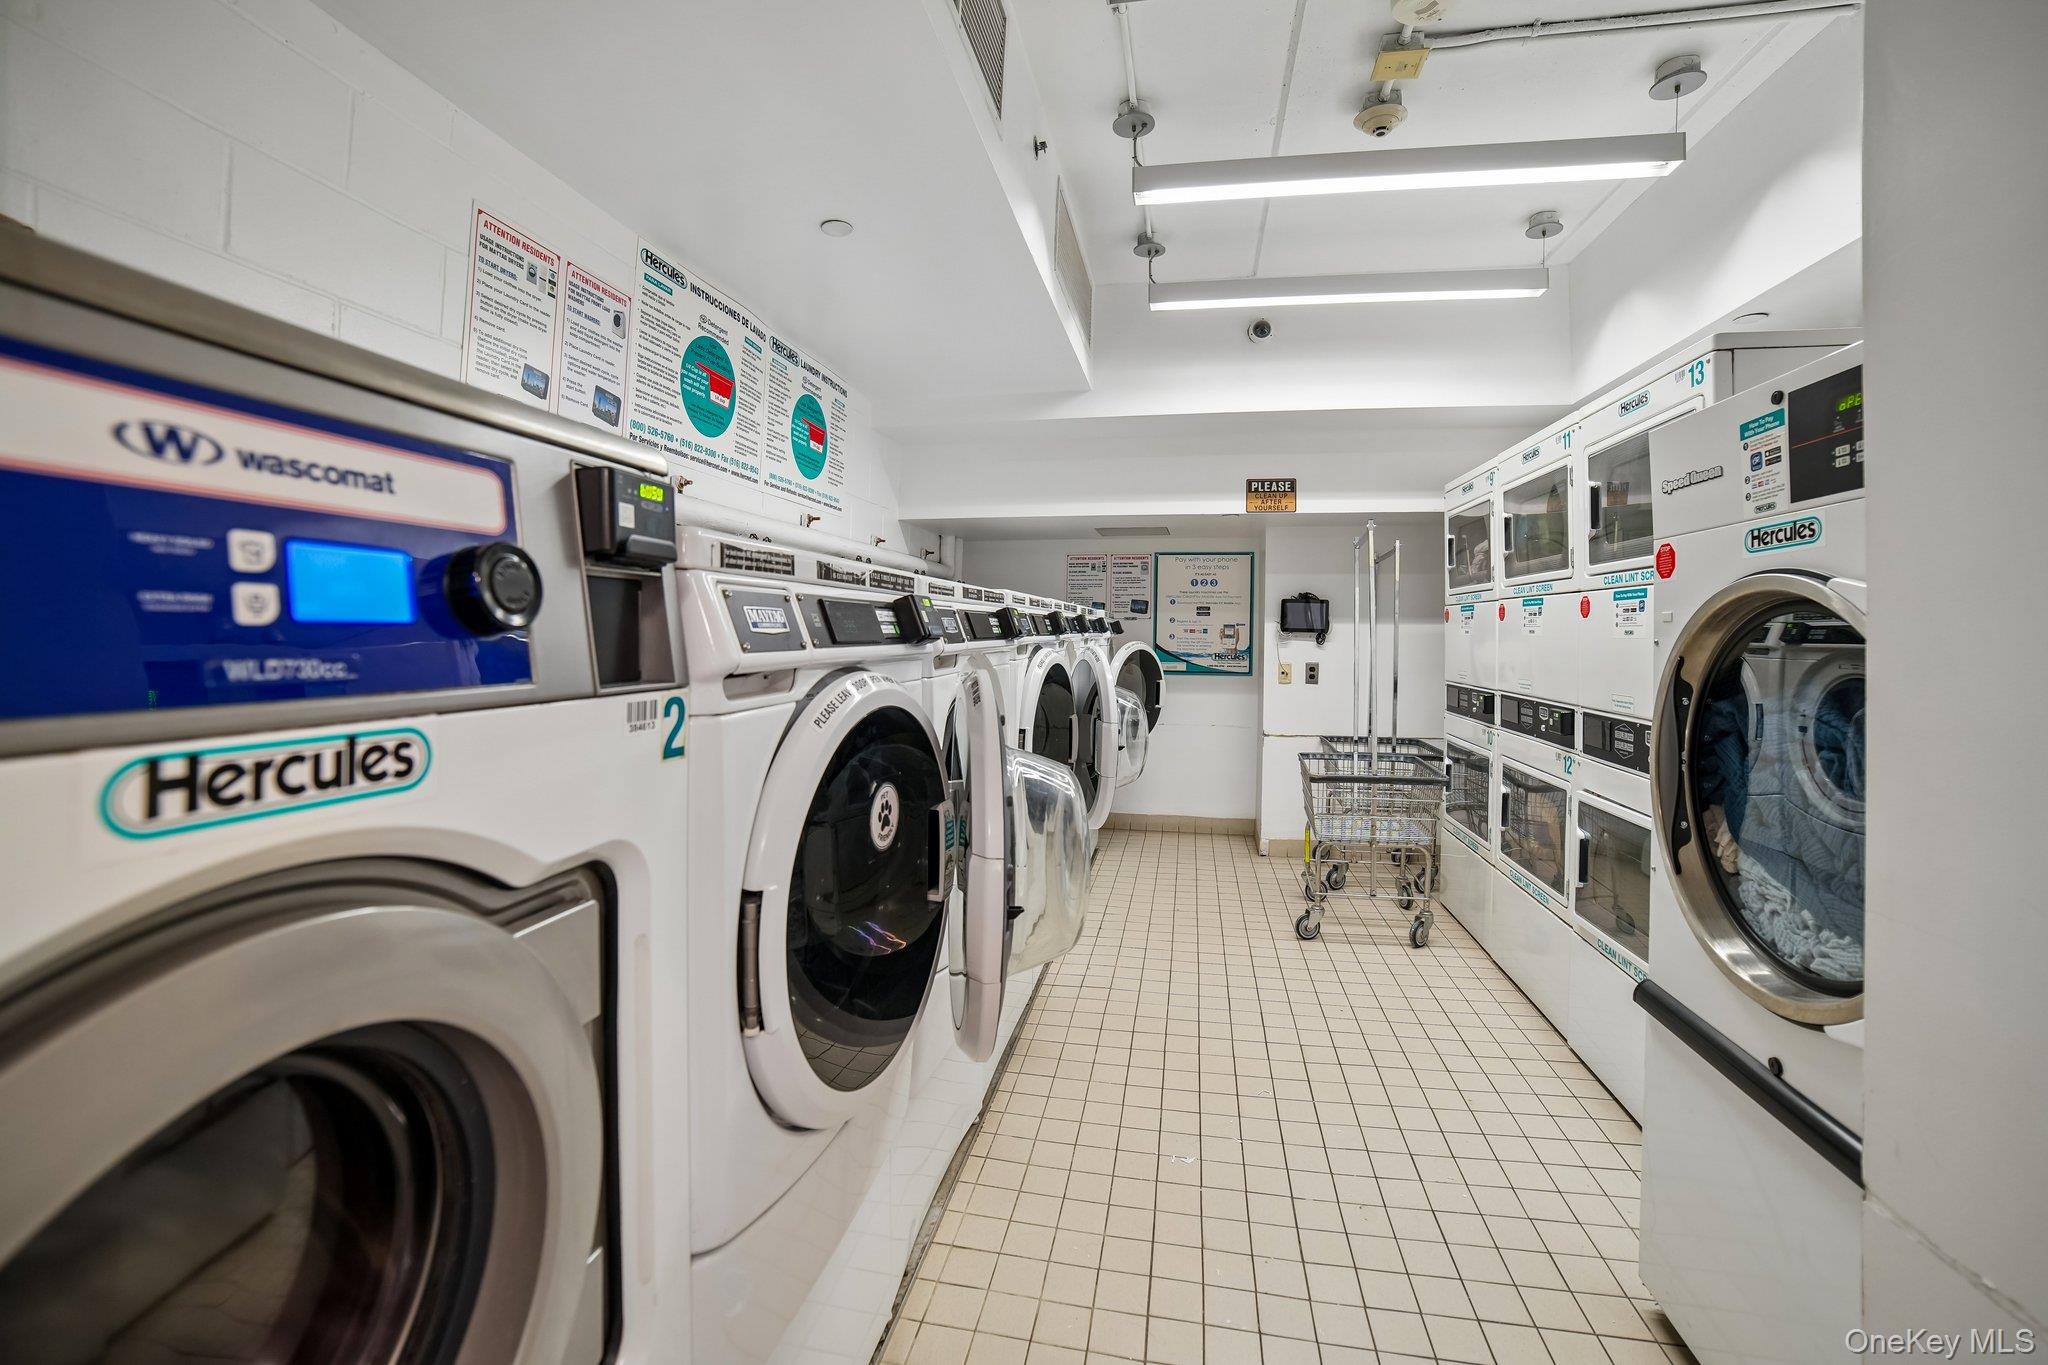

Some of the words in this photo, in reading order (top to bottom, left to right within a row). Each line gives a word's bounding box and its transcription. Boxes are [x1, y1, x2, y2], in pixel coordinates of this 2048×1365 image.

[483, 219, 519, 247] ATTENTION
[521, 241, 554, 266] RESIDENTS
[644, 248, 684, 286] Hercules
[571, 270, 600, 292] ATTENTION
[601, 286, 626, 307] RESIDENTS
[689, 282, 740, 323] INSTRUCCIONES
[741, 315, 749, 328] DE
[749, 321, 766, 343] LAVADO
[697, 321, 728, 345] Recommended
[771, 336, 798, 365] Hercules
[800, 358, 820, 379] LAUNDRY
[821, 372, 847, 398] INSTRUCTIONS
[1688, 360, 1705, 388] 13
[1620, 393, 1649, 415] Hercules
[1745, 430, 1755, 438] With
[1755, 426, 1765, 434] Your
[1765, 421, 1779, 430] Phone
[1765, 416, 1774, 424] Pay
[629, 417, 646, 434] (800)
[647, 424, 674, 443] 526-5760
[679, 437, 693, 451] (516)
[629, 431, 638, 441] Por
[638, 435, 659, 449] Servicios
[659, 444, 662, 452] y
[1563, 430, 1571, 450] 11
[1522, 448, 1540, 462] Hercules
[235, 446, 397, 496] wascomat
[1489, 471, 1495, 486] 9
[1662, 473, 1691, 495] Speed
[1690, 466, 1723, 485] Queen
[1251, 481, 1292, 492] PLEASE
[1755, 503, 1776, 512] Hercules
[1750, 521, 1816, 548] Hercules
[1513, 586, 1526, 594] CLEAN
[1535, 584, 1553, 592] SCREEN
[1603, 574, 1623, 585] CLEAN
[1625, 572, 1639, 583] LINT
[747, 609, 785, 623] MAYTAG
[813, 699, 840, 729] PLEASE
[662, 696, 686, 760] 2
[1486, 730, 1494, 745] 10
[145, 734, 415, 820] Hercules
[1563, 755, 1573, 775] 12
[1510, 869, 1523, 883] CLEAN
[1522, 879, 1531, 890] LINT
[1532, 886, 1550, 905] SCREEN
[1597, 938, 1617, 960] CLEAN
[1617, 954, 1632, 972] LINT
